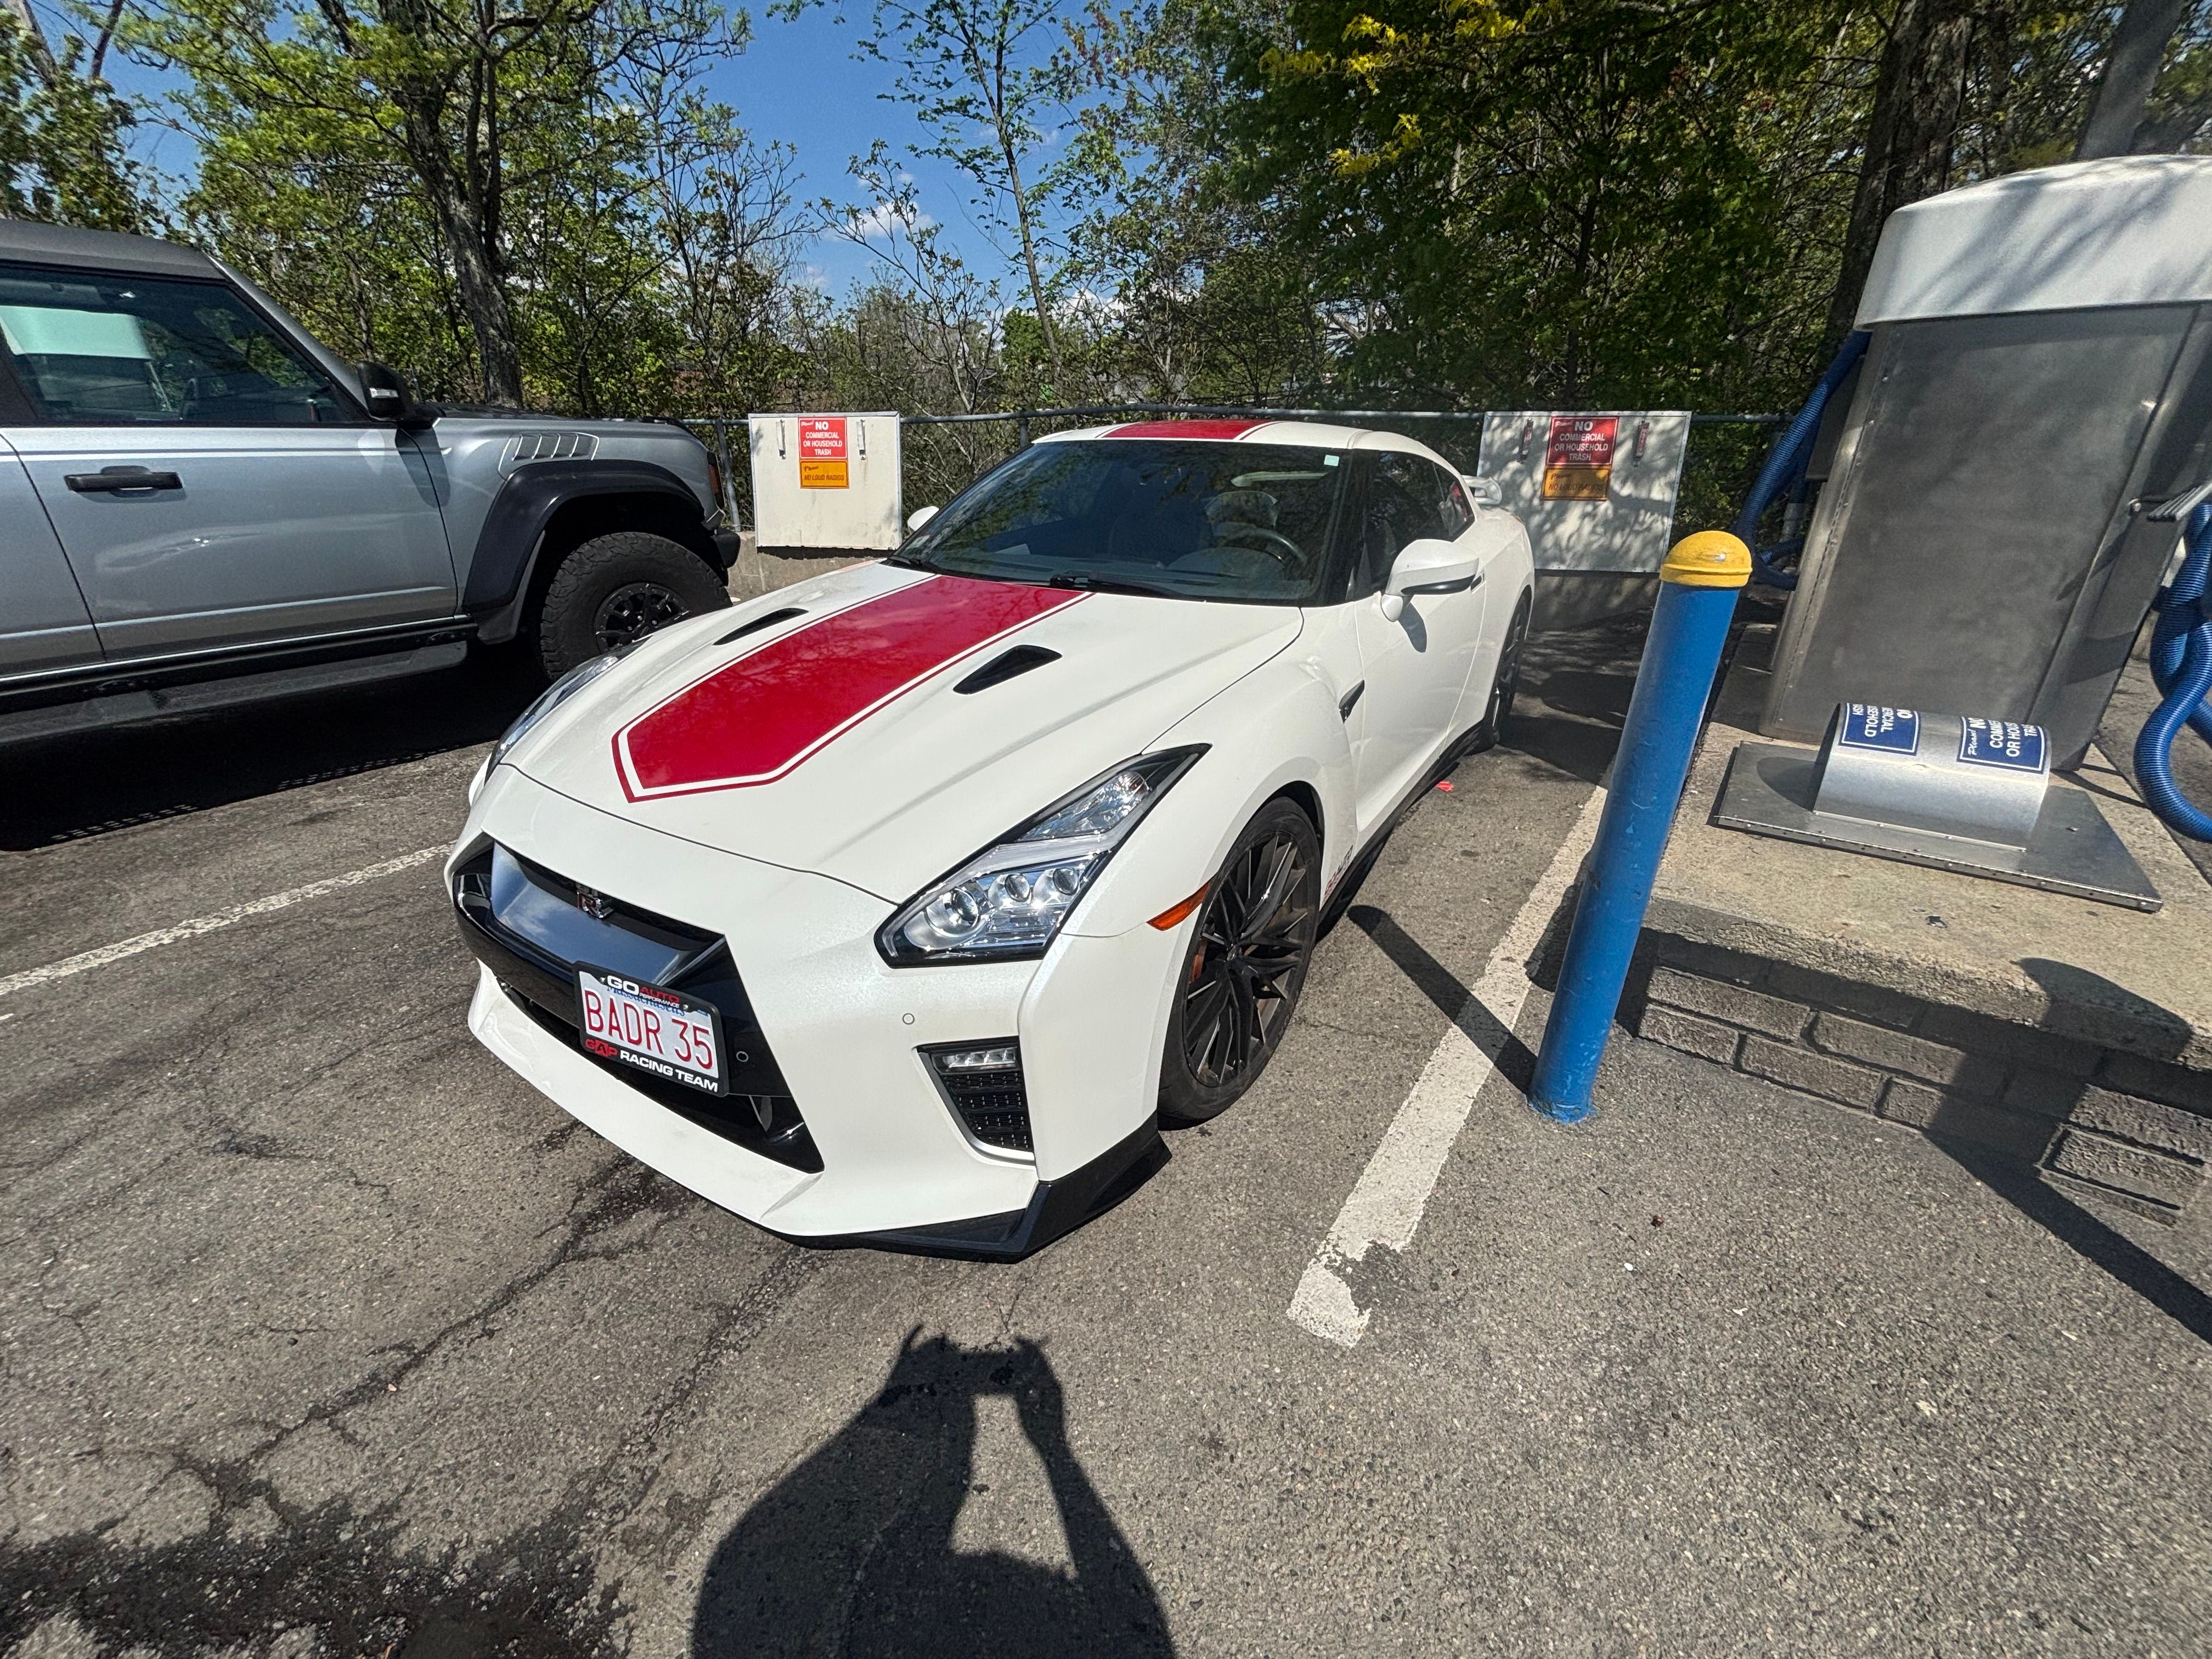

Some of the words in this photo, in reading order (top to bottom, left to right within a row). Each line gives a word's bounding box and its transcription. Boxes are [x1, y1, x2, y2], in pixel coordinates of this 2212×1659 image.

[815, 421, 829, 430] NO
[1575, 421, 1593, 431] NO
[2004, 721, 2021, 740] HOUS
[2006, 741, 2021, 757] OR
[607, 975, 640, 995] GO
[640, 986, 680, 1003] AUTO
[639, 992, 680, 1008] PERFORMANCE
[584, 989, 664, 1054] BADR
[672, 1018, 713, 1069] 35
[585, 1037, 618, 1057] GAP
[620, 1049, 674, 1076] RACING
[675, 1069, 718, 1093] TEAM
